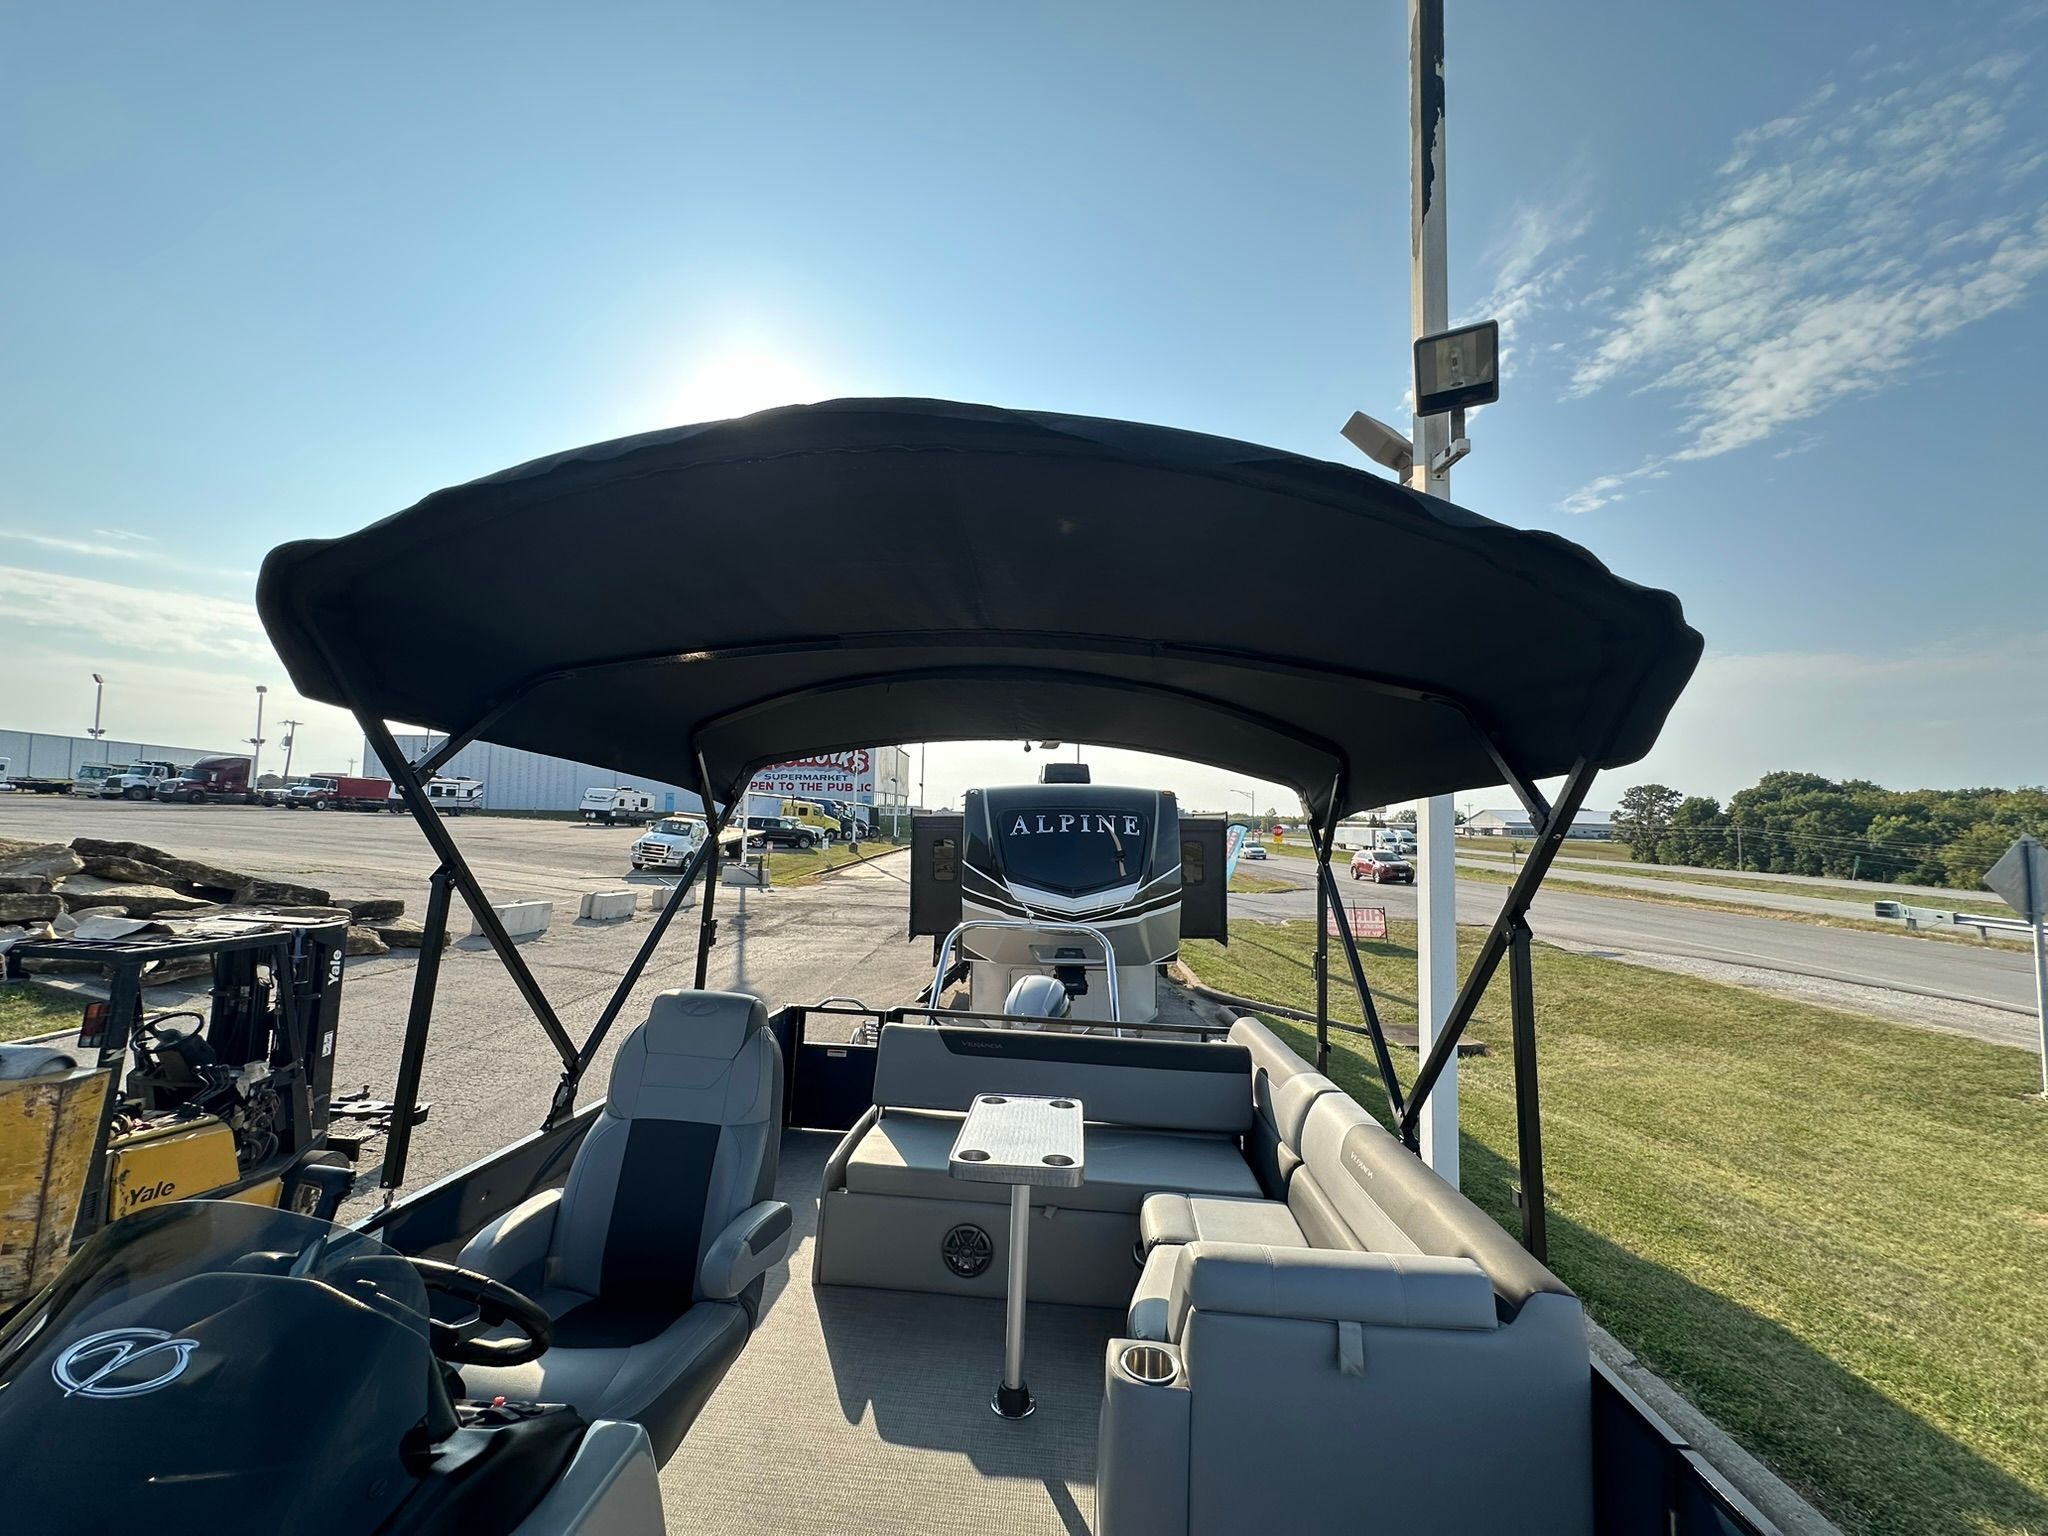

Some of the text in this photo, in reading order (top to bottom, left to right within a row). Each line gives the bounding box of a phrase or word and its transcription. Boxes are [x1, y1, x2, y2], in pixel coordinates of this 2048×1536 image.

[750, 782, 774, 791] PEN
[779, 782, 795, 791] TO
[799, 782, 823, 792] THE
[764, 774, 848, 782] SUPERMARKET
[1009, 814, 1140, 836] ALPINE
[327, 949, 342, 986] Yale
[130, 1181, 175, 1206] Yale
